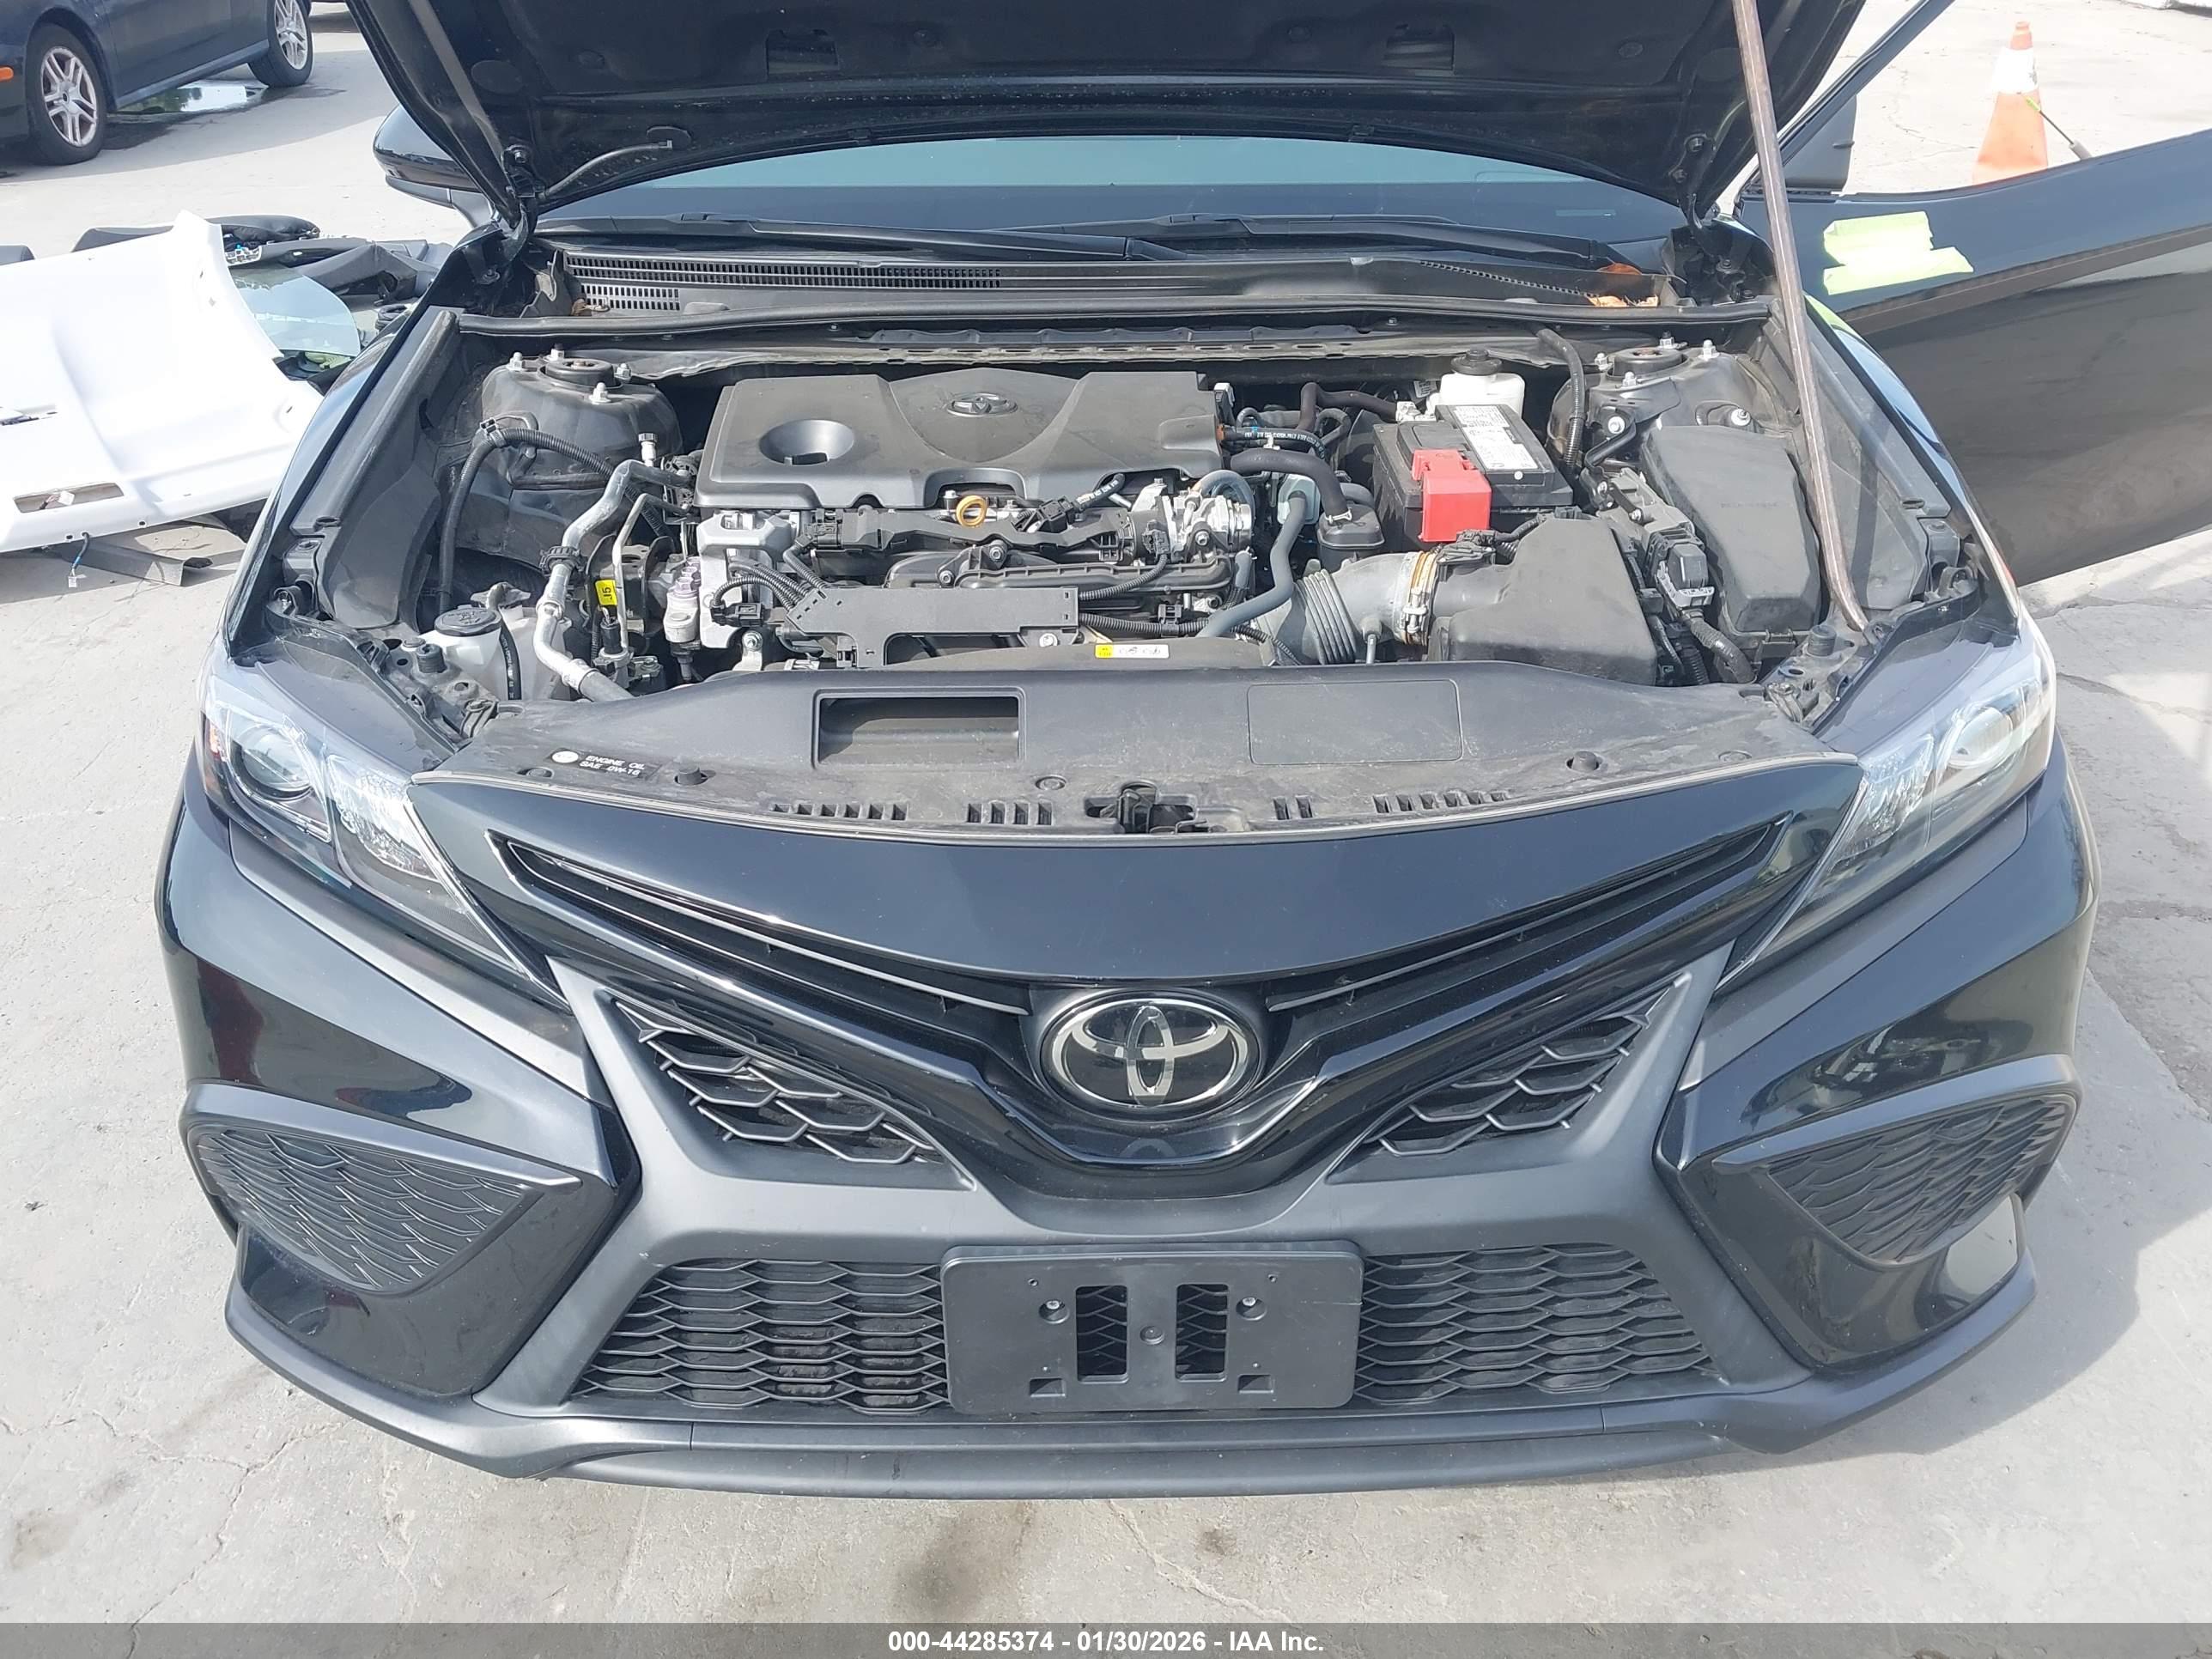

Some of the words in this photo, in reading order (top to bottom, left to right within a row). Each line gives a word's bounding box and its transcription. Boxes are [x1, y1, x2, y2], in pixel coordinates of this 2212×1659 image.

[585, 755, 625, 767] ENGINE
[579, 761, 603, 769] SAE
[606, 765, 641, 775] 0W-16
